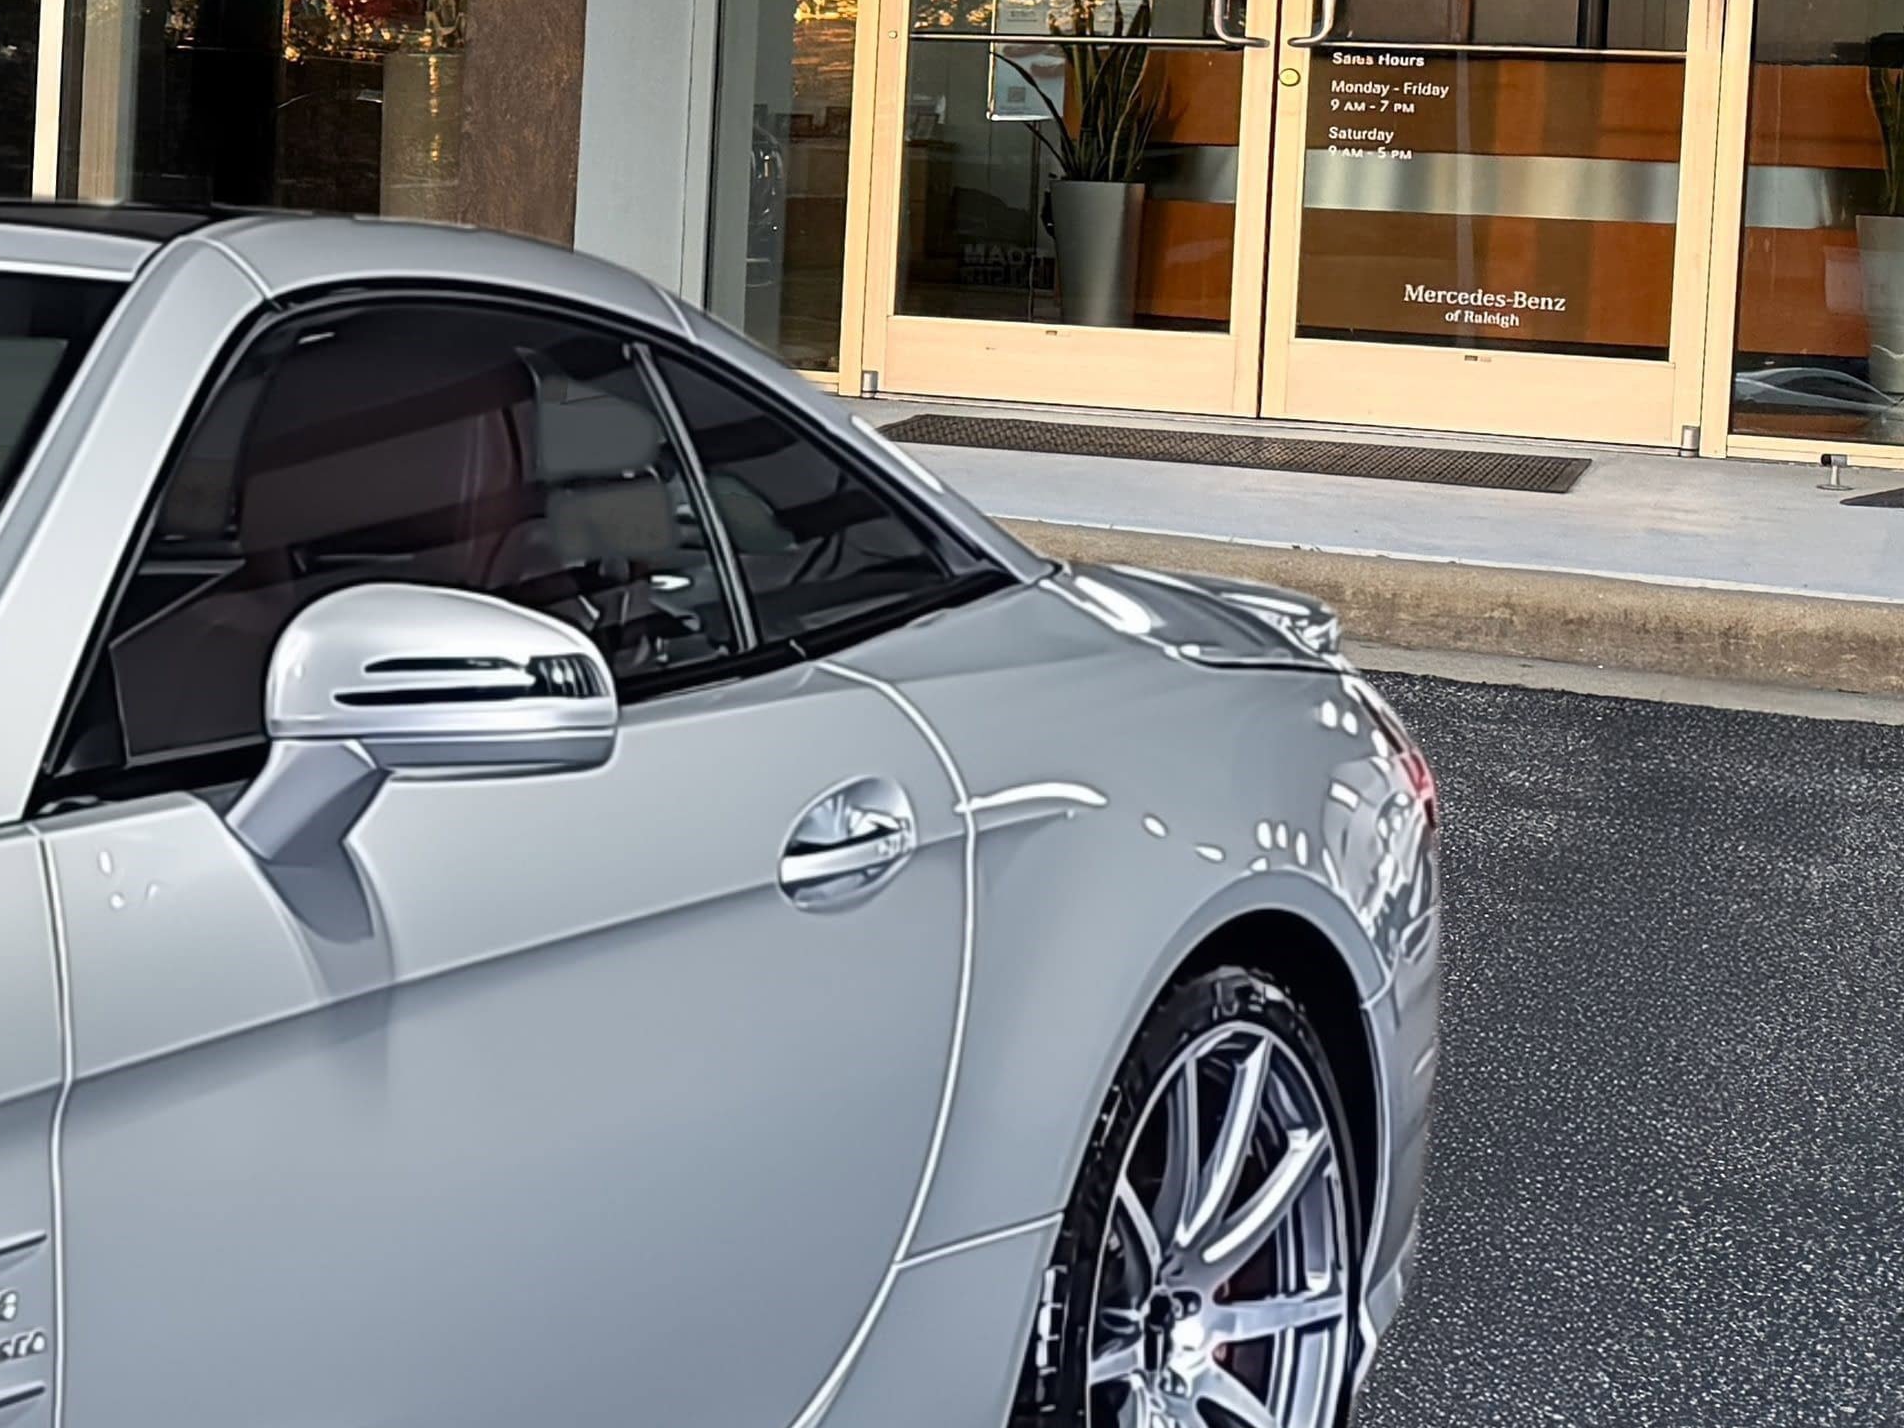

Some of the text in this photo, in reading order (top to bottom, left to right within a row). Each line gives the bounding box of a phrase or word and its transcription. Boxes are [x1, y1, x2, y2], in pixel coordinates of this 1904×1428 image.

[1377, 52, 1425, 67] Hours
[1330, 79, 1391, 97] Monday
[1403, 82, 1450, 99] Friday
[1330, 98, 1340, 111] 9
[1343, 101, 1366, 112] AM
[1380, 99, 1389, 112] 7
[1393, 102, 1415, 114] PM
[1328, 126, 1394, 144] Saturday
[1327, 145, 1337, 157] 9
[1341, 148, 1364, 159] AM
[1377, 146, 1386, 159] 5
[1391, 149, 1412, 160] PM
[1403, 283, 1566, 312] Mercedes-Benz
[1445, 309, 1520, 329] of Raleigh
